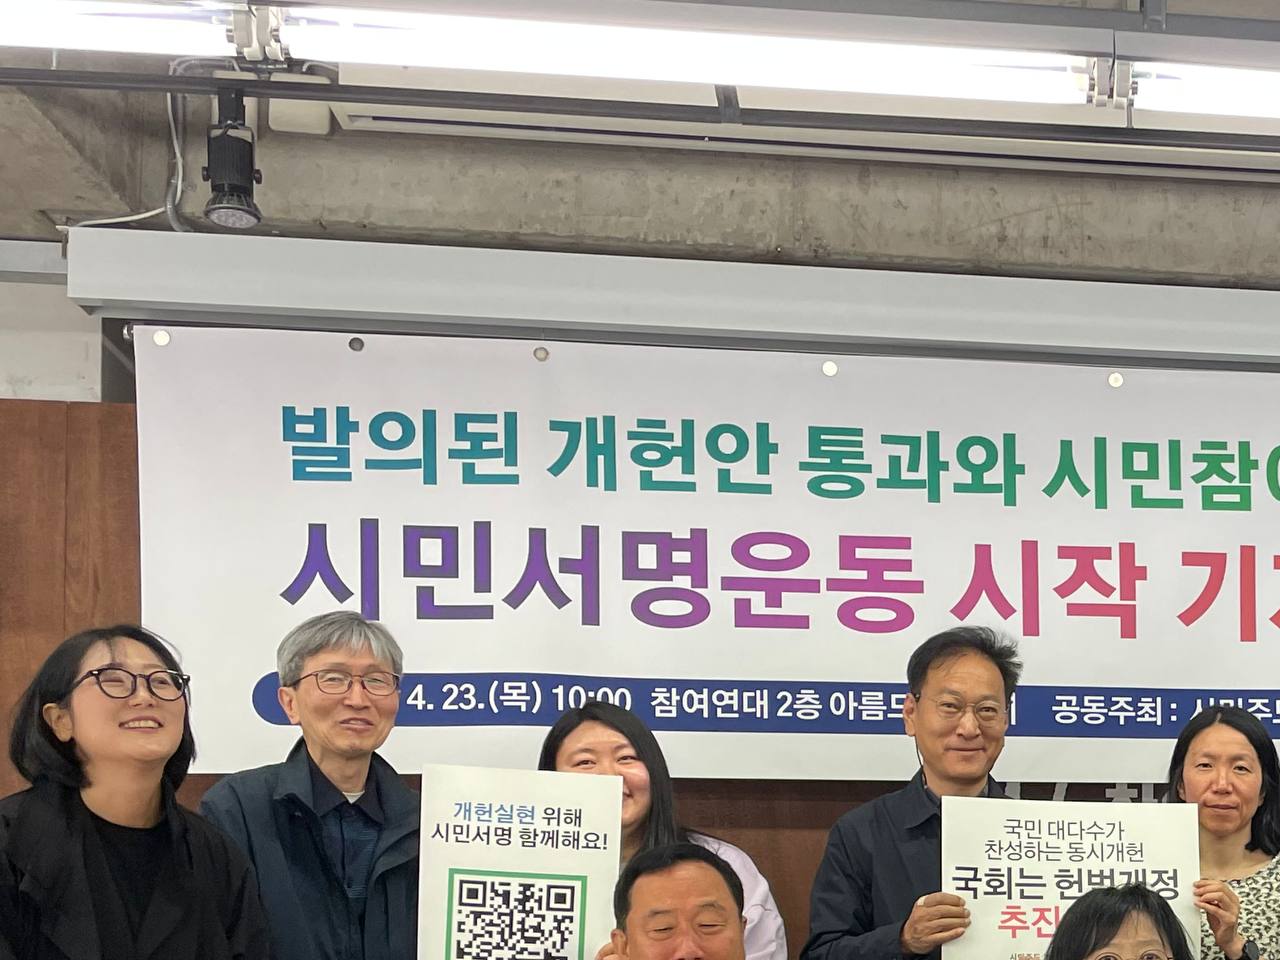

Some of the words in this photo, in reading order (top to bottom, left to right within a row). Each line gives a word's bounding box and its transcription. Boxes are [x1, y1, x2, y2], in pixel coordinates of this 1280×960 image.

[281, 405, 520, 485] 발의된
[549, 415, 779, 496] 개헌안
[798, 426, 1025, 506] 통과와
[281, 517, 924, 634] 시민서명운동
[951, 538, 1148, 640] 시작
[406, 684, 434, 710] 4.
[442, 680, 542, 713] 23.(목)
[650, 687, 769, 719] 참여연대
[776, 689, 822, 720] 2층
[453, 801, 536, 825] 개헌실현
[541, 807, 582, 827] 위해
[1003, 818, 1042, 840] 국민
[1048, 819, 1125, 841] 대다수가
[431, 822, 512, 846] 시민서명
[519, 827, 608, 851] 함께해요!
[984, 839, 1063, 862] 찬성하는
[1066, 841, 1144, 863] 동시개헌
[951, 866, 1047, 900] 국회는
[998, 905, 1059, 938] 추진
